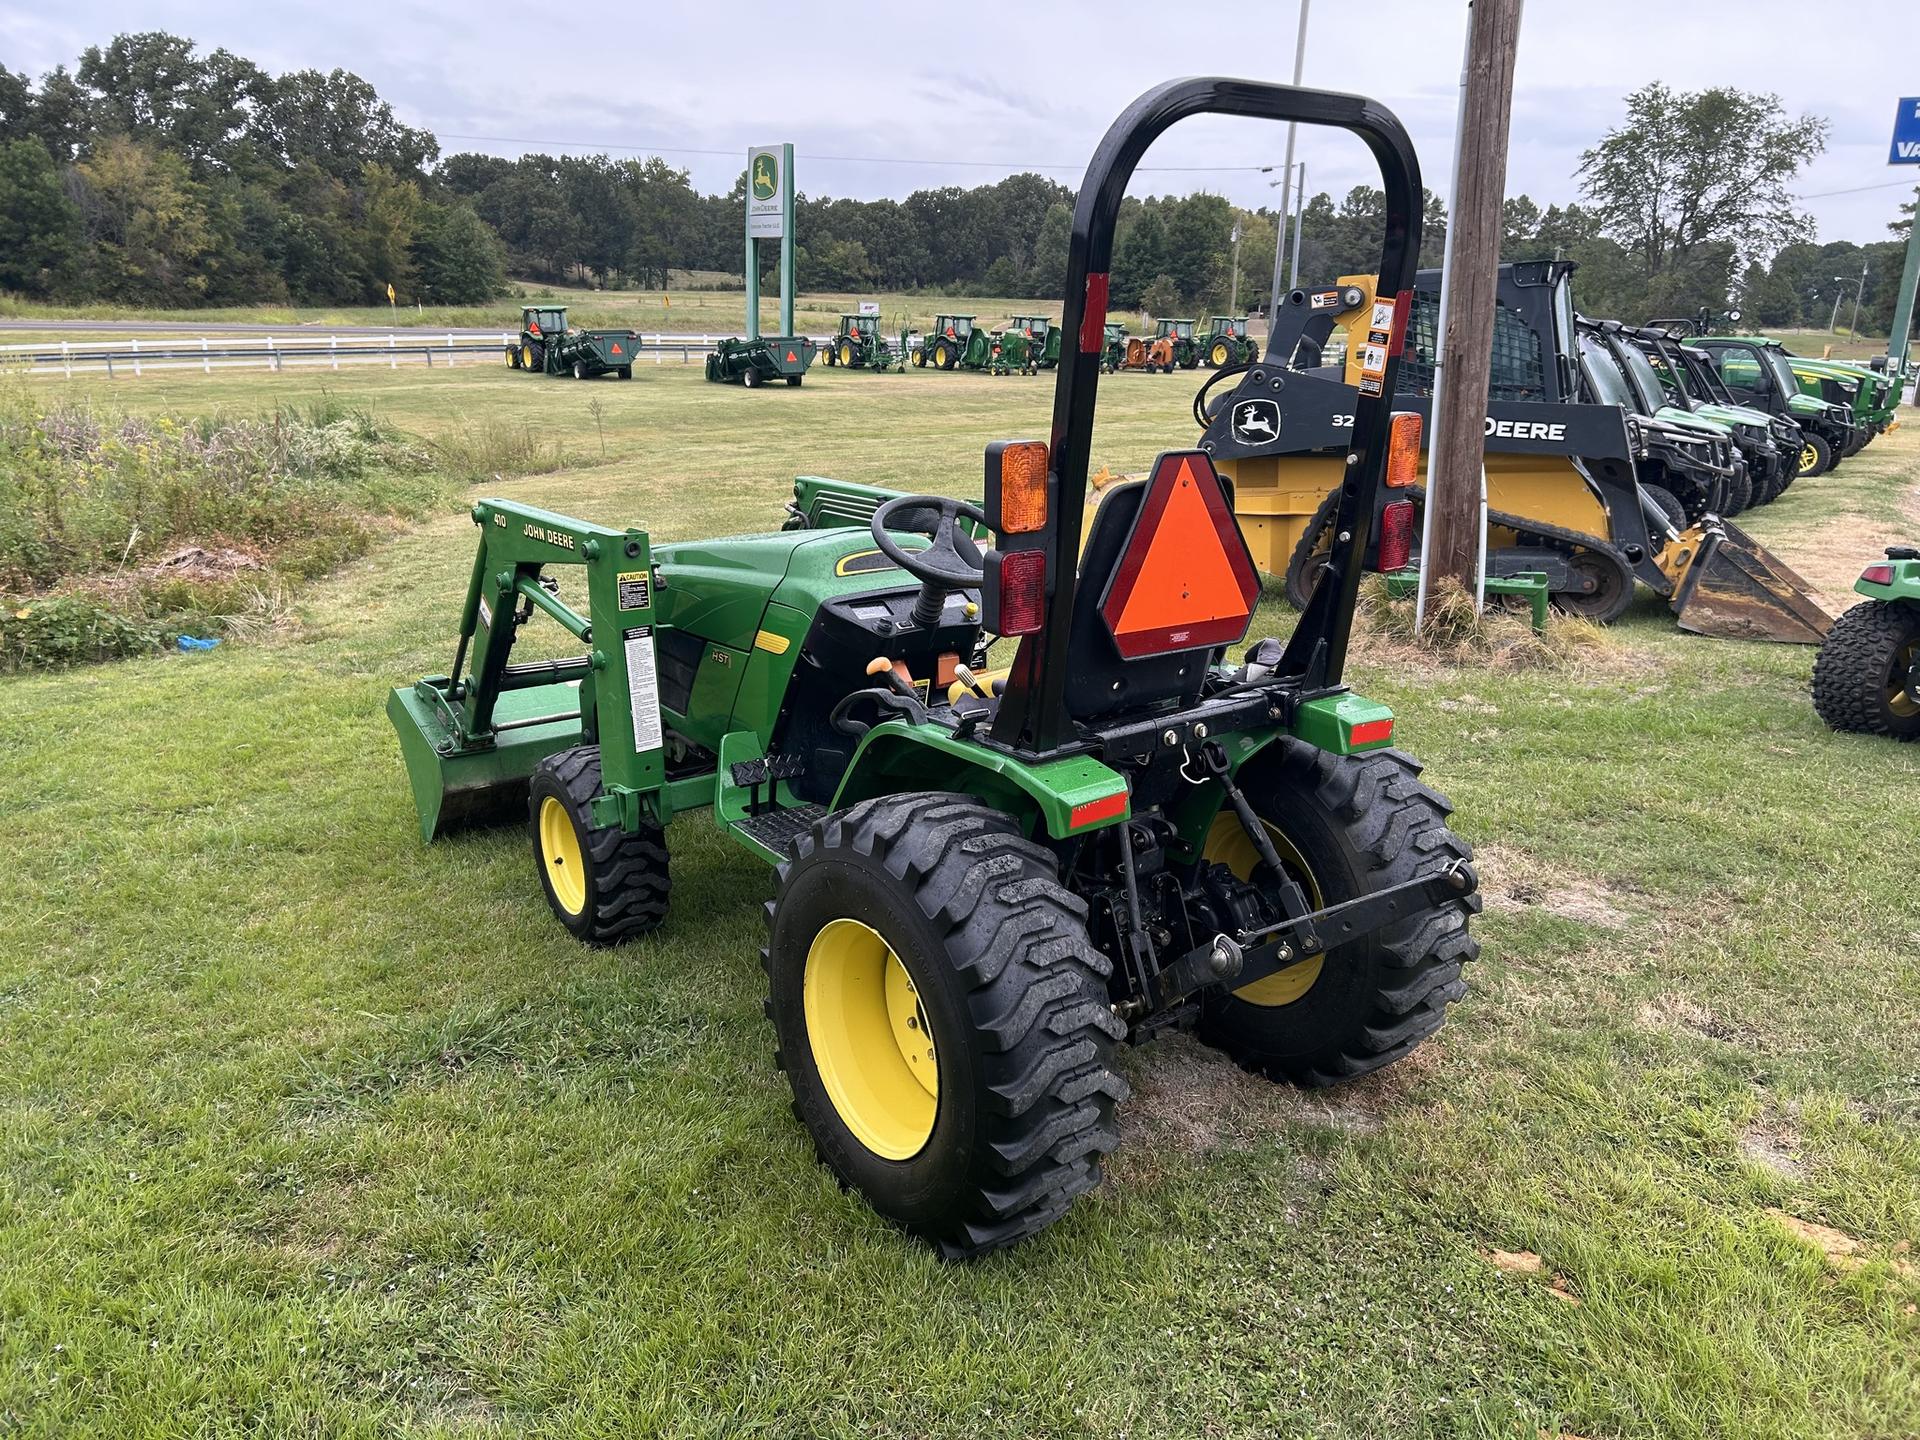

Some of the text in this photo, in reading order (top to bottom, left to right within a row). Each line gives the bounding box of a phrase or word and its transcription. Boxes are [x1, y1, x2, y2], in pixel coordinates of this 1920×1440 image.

[1485, 416, 1567, 441] DEERE
[494, 513, 507, 528] 410
[523, 523, 575, 550] JOHN DEERE
[626, 573, 648, 581] CAUTION
[712, 651, 729, 664] HST
